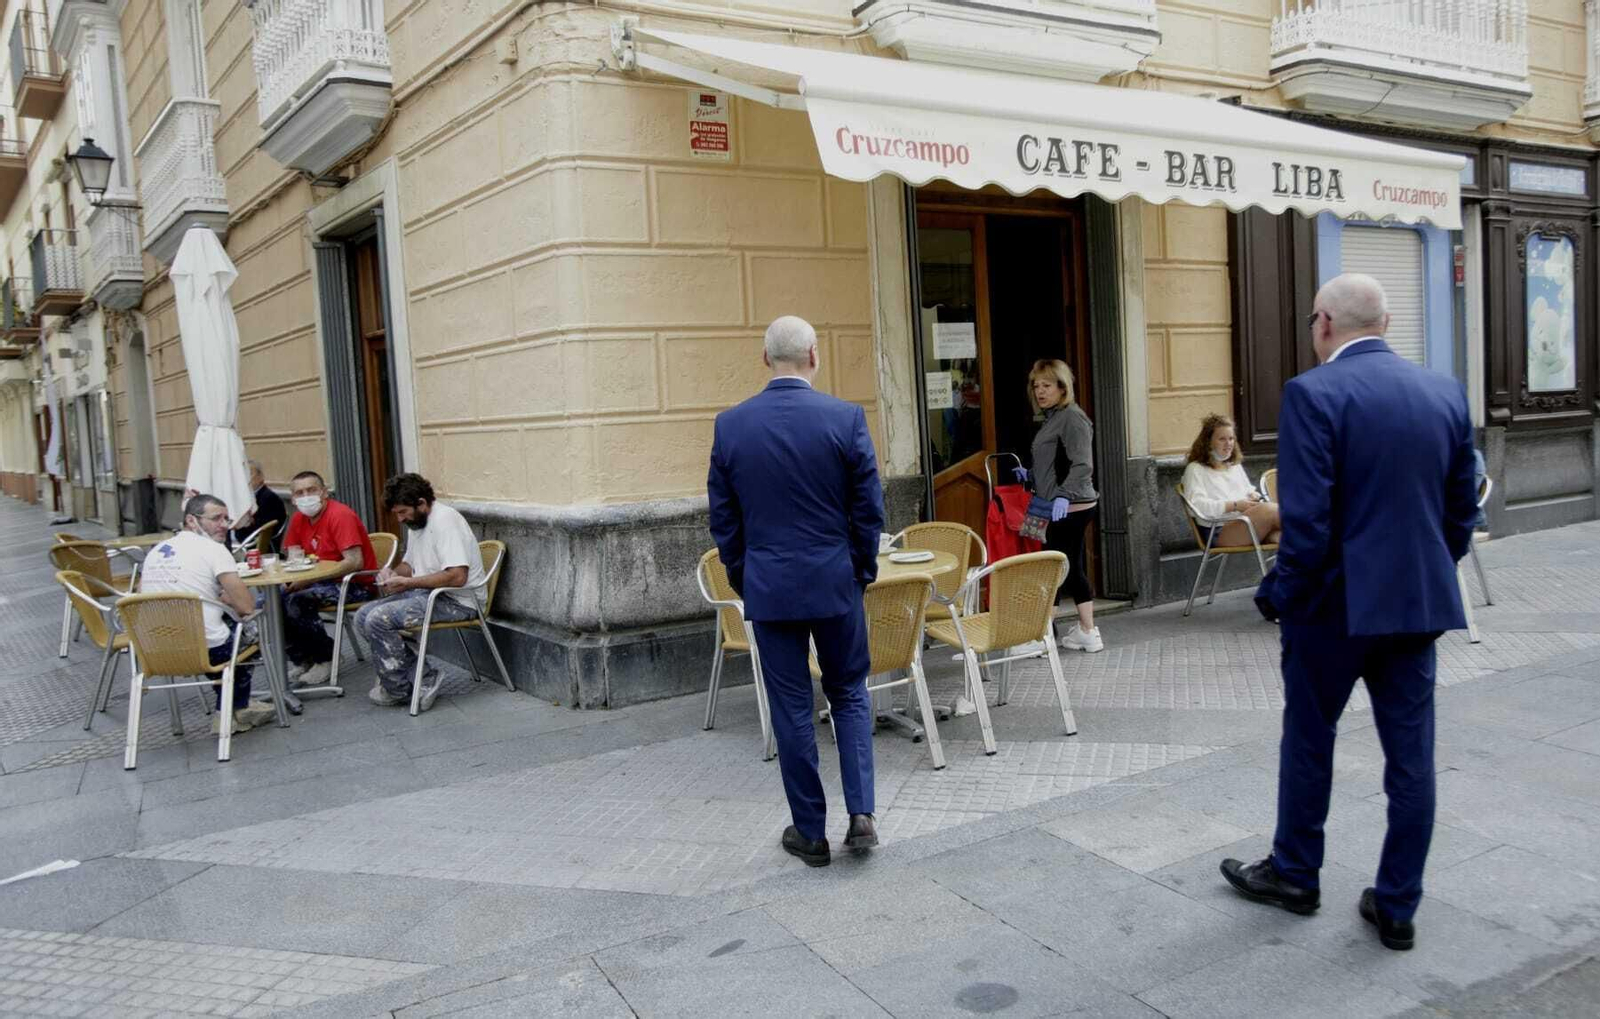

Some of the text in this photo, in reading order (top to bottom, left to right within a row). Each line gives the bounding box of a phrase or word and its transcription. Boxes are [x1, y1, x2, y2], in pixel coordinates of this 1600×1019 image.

[692, 122, 726, 132] Alarma
[835, 125, 970, 168] Cruzcampo
[1016, 134, 1122, 182] CAFE
[1164, 150, 1236, 193] BAR
[1271, 161, 1346, 202] LIBA
[1373, 179, 1448, 209] Cruzcampo
